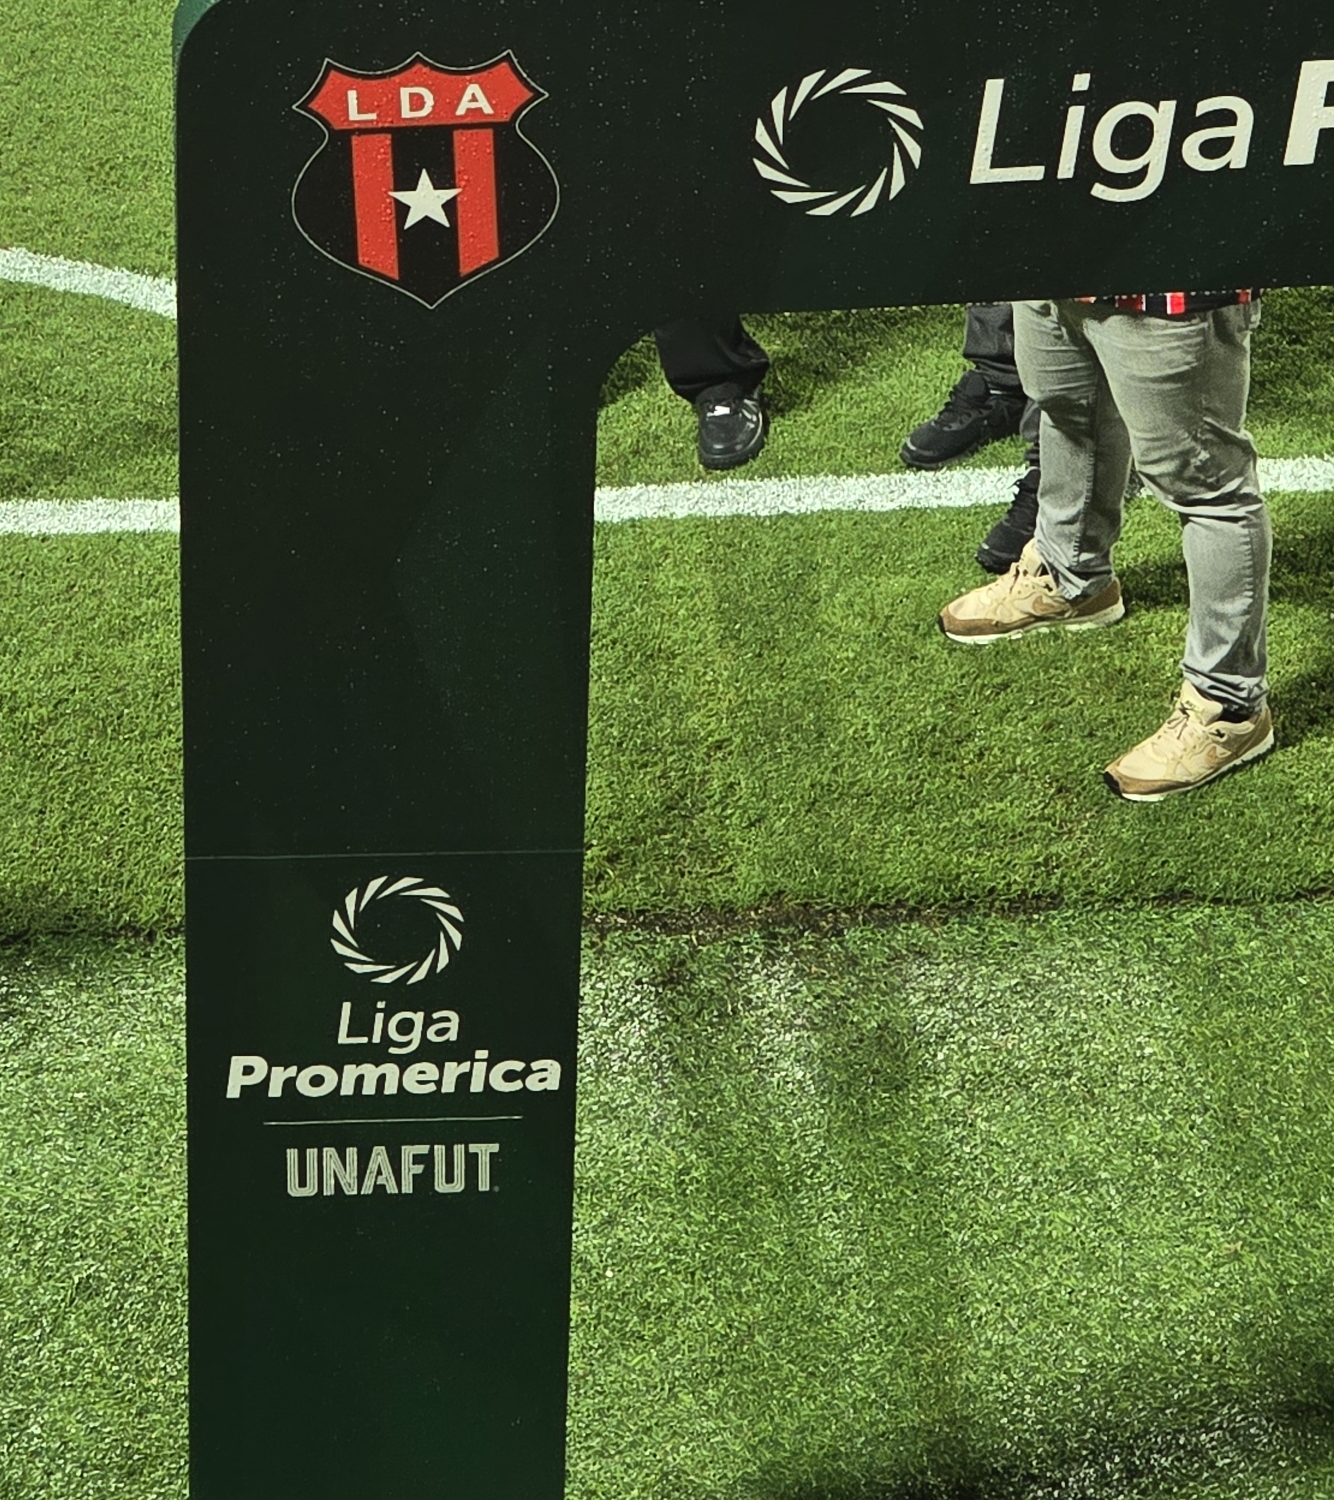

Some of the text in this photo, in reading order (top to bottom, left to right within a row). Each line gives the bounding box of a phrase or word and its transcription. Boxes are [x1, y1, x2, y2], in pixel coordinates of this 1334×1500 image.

[347, 83, 494, 121] LDA
[969, 72, 1255, 202] Liga
[337, 1000, 460, 1055] Liga
[225, 1049, 562, 1099] Promerica
[286, 1143, 500, 1197] UNAFUT
